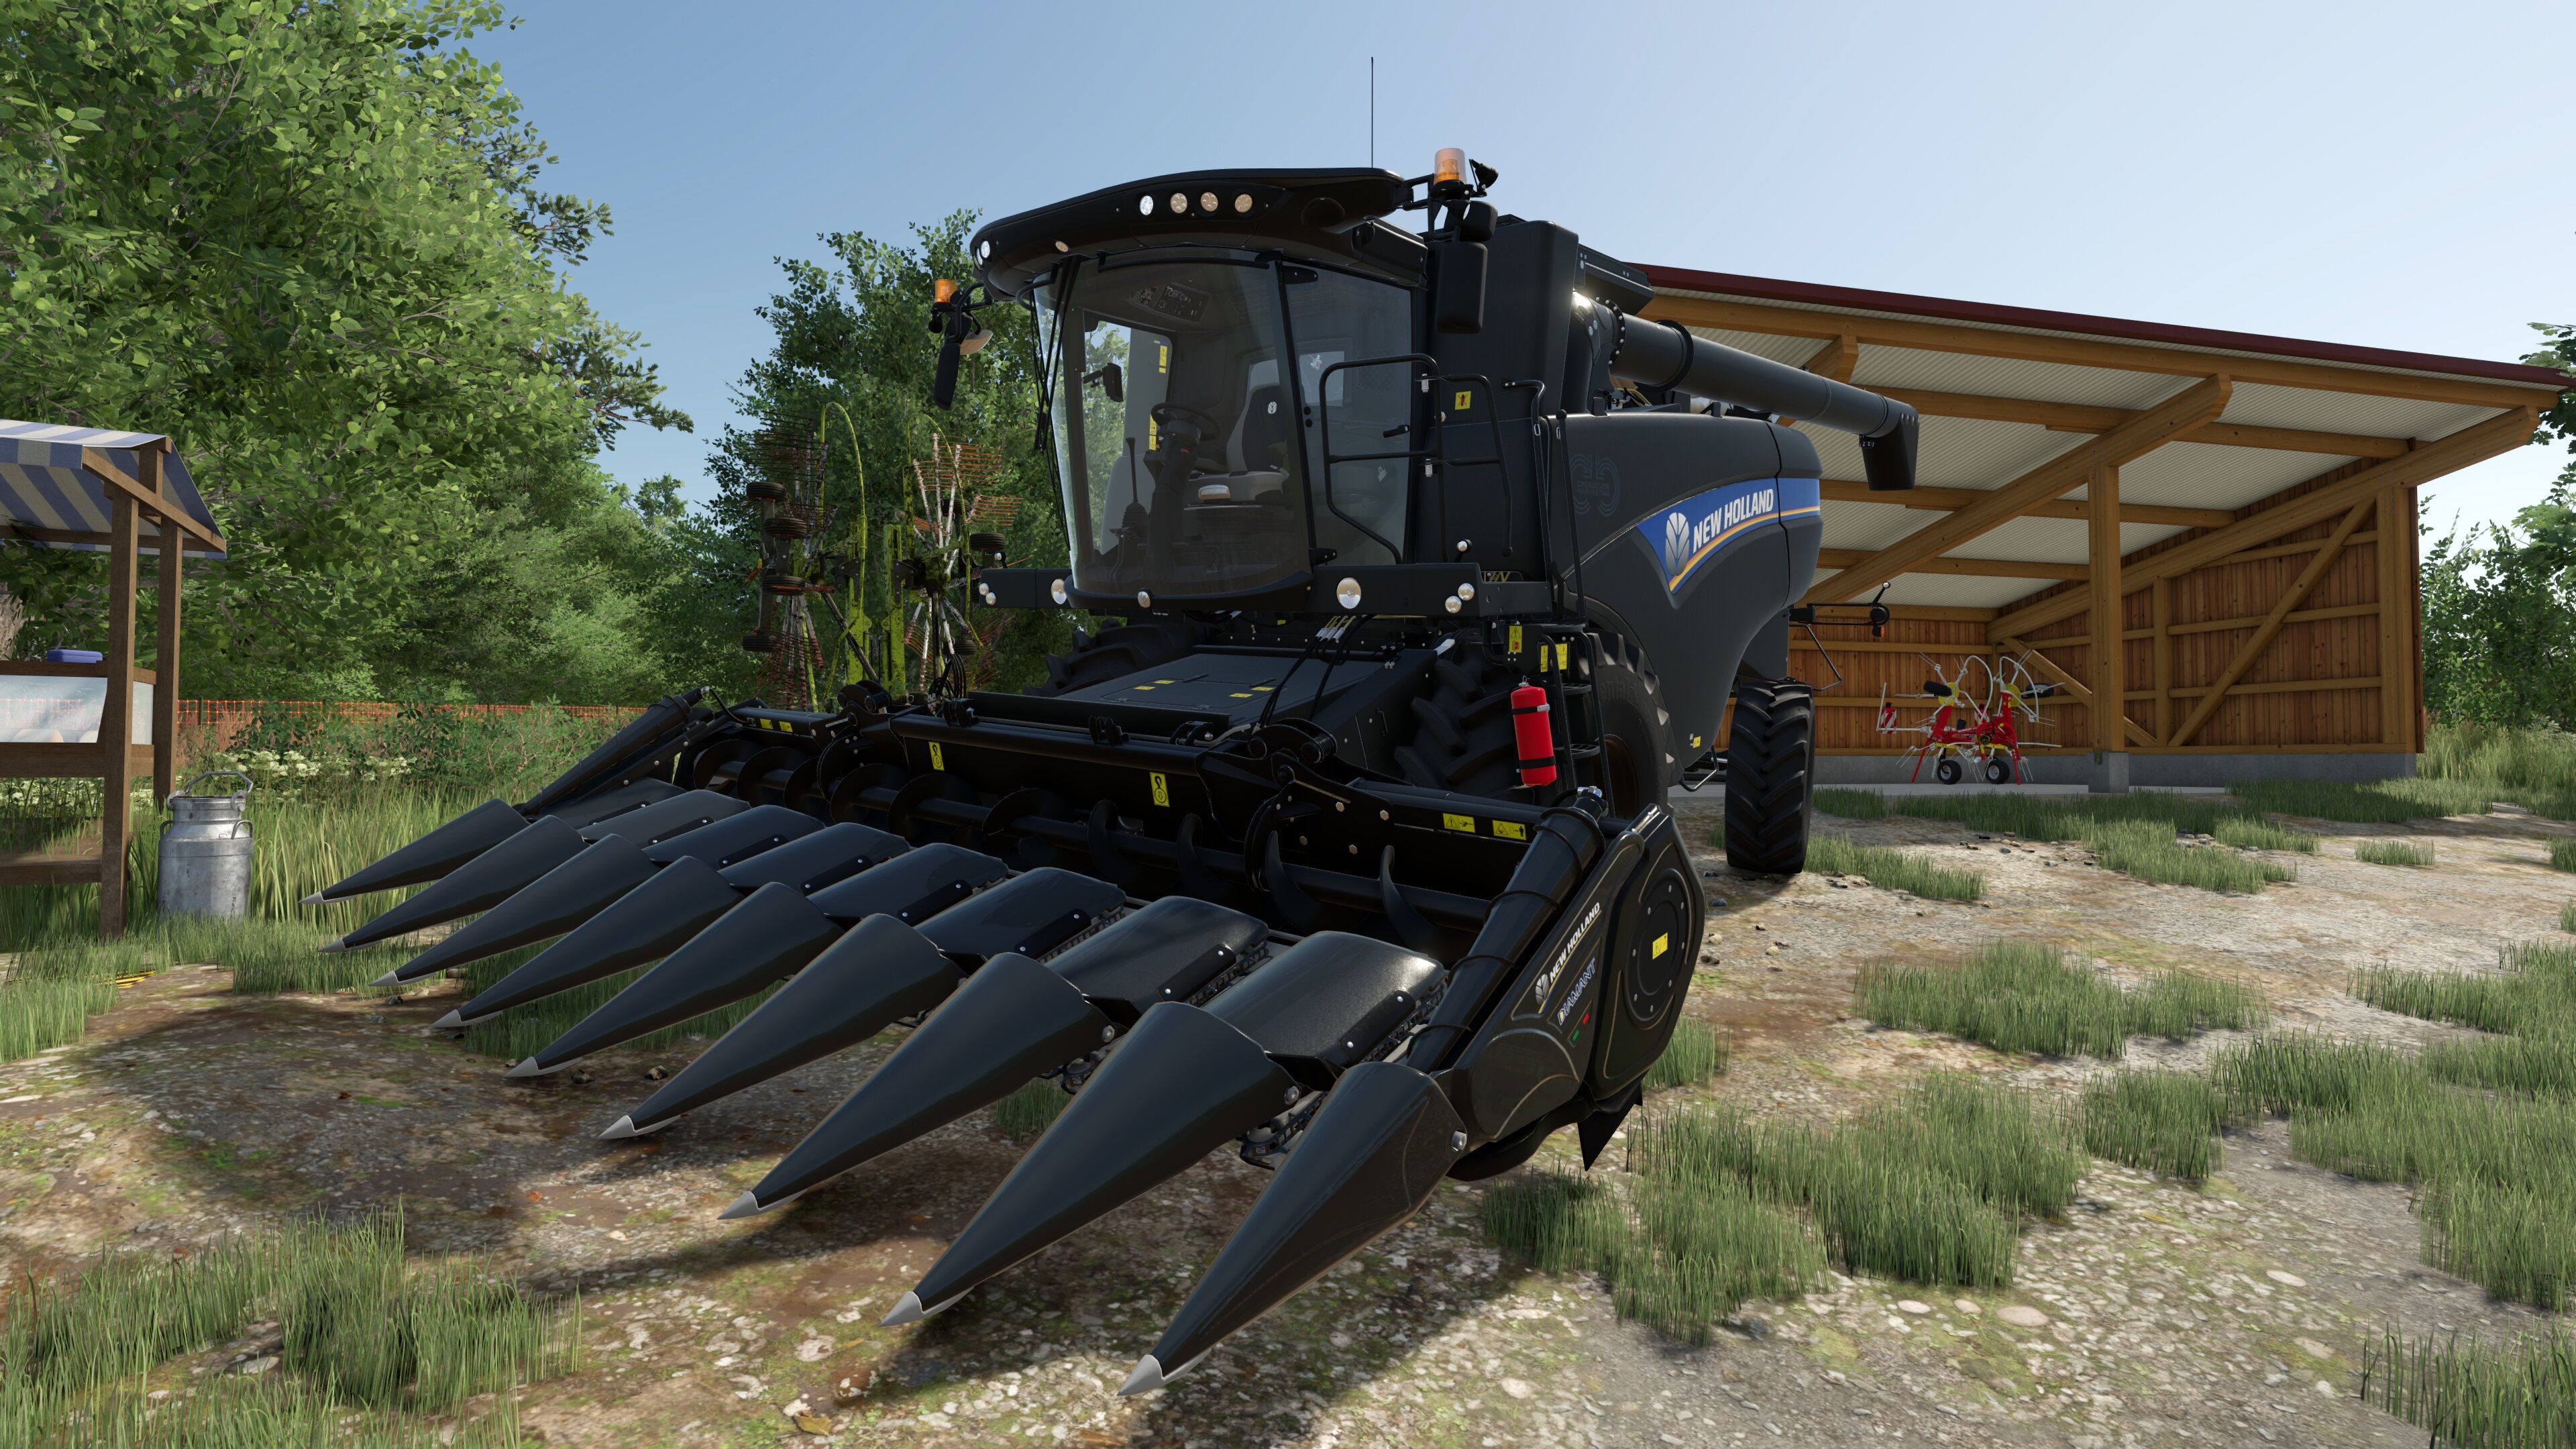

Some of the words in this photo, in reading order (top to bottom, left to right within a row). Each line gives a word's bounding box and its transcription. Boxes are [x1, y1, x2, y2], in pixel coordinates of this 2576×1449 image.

[1693, 507, 1723, 553] NEW
[1723, 488, 1774, 530] HOLLAND
[1550, 949, 1567, 984] NEW
[1567, 902, 1601, 955] HOLLAND
[1557, 957, 1596, 1026] DIAMANT
